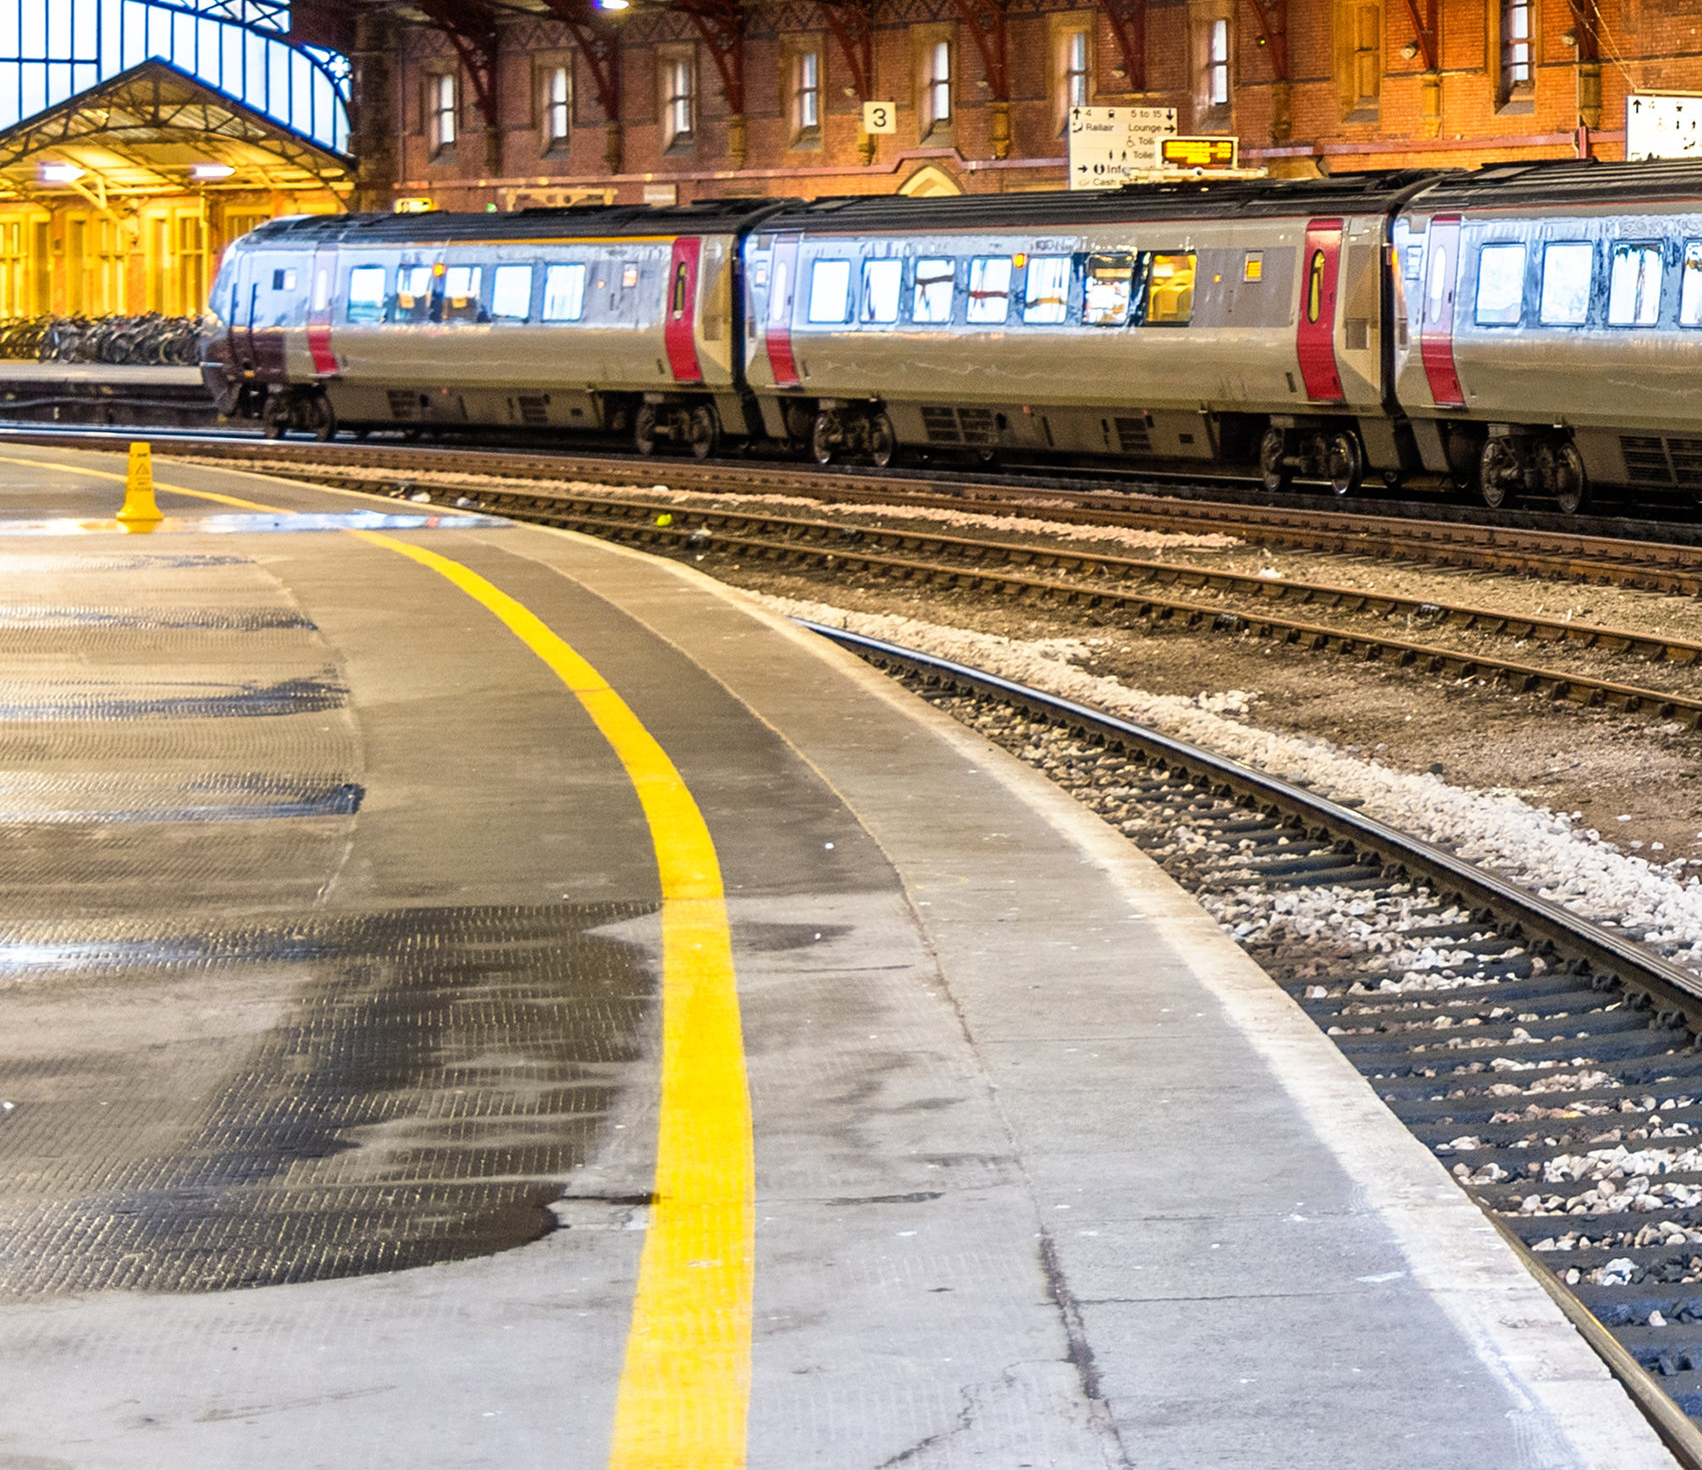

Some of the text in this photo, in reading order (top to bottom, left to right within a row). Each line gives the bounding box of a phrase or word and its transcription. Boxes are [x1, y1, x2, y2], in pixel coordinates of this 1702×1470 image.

[873, 108, 887, 127] 3
[1131, 109, 1162, 118] 5 to 15
[1128, 124, 1162, 133] Lounge
